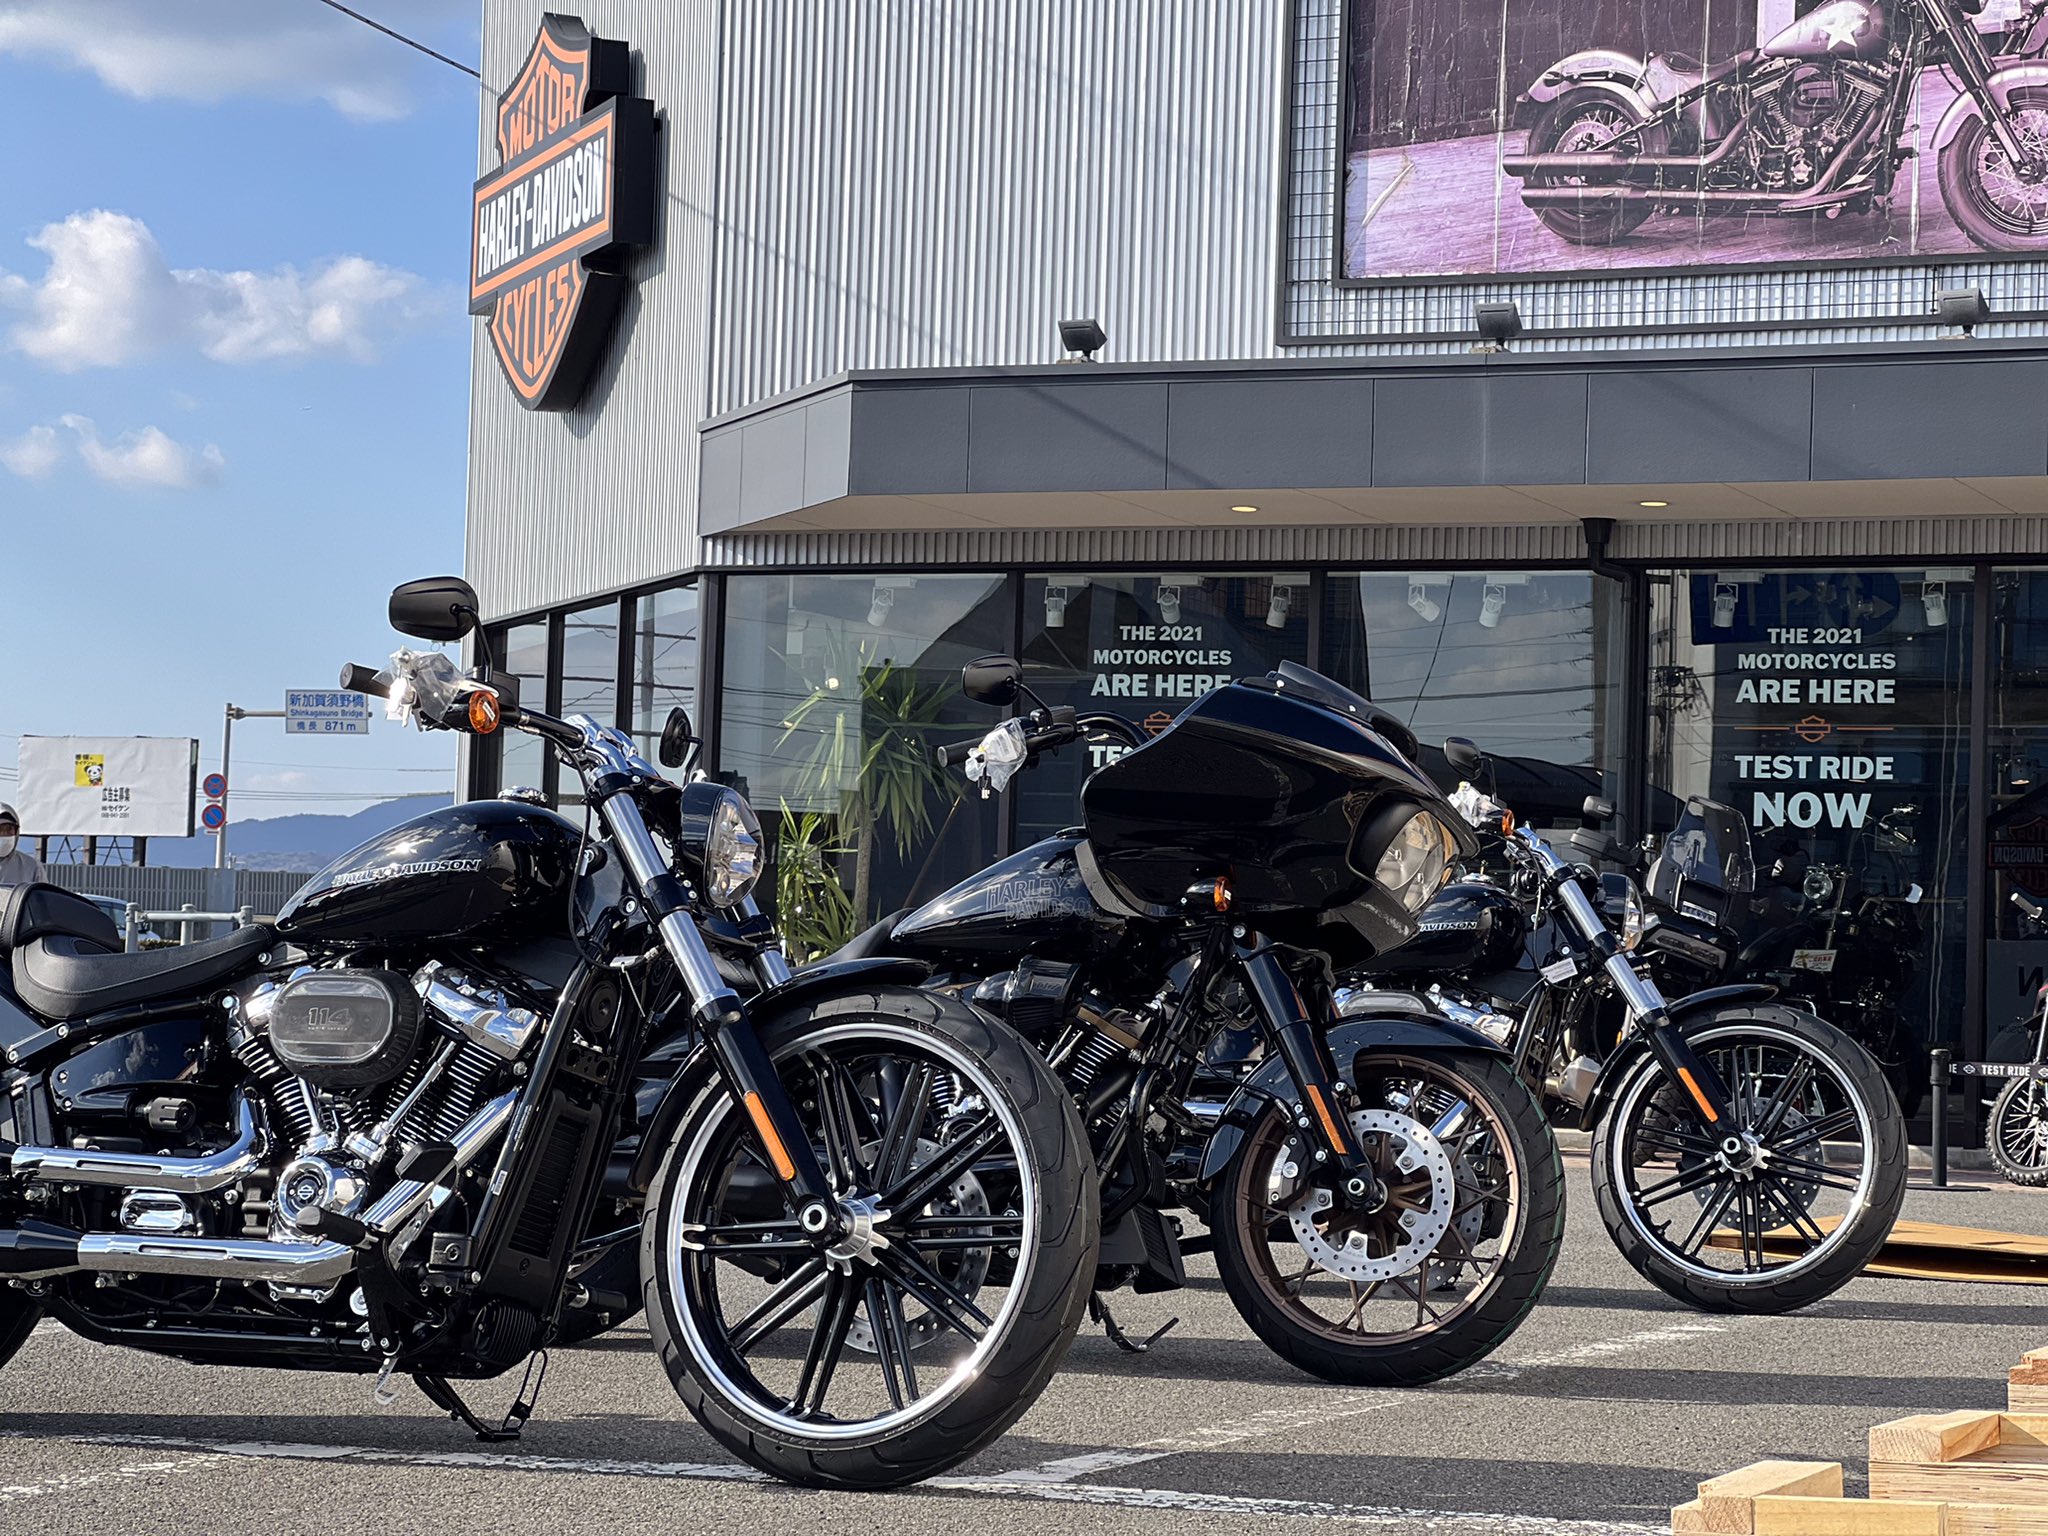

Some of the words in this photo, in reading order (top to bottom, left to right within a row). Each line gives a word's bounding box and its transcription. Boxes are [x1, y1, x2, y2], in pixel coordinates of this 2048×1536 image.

[509, 54, 576, 158] MOTOR
[478, 137, 604, 278] HARLEY-DAVIDSON
[502, 262, 570, 379] CYCLES
[1119, 625, 1156, 641] THE
[1159, 625, 1202, 641] 2021
[1767, 628, 1808, 644] THE
[1812, 628, 1862, 644] 2021
[1093, 649, 1232, 666] MOTORCYCLES
[1738, 653, 1896, 670] MOTORCYCLES
[1090, 673, 1149, 697] ARE
[1735, 679, 1801, 704] ARE
[1808, 679, 1896, 704] HERE
[289, 693, 364, 708] 新加賀須野橋
[290, 708, 339, 718] Shinkagasuno
[340, 709, 364, 718] Bridge
[1734, 755, 1813, 779] TEST
[1819, 756, 1894, 780] RIDE
[1753, 791, 1872, 829] NOW
[985, 878, 1067, 912] HARLEY
[1005, 897, 1092, 921] DAVIDSO
[1418, 921, 1478, 932] AVIDSON
[308, 1007, 352, 1026] 114
[1981, 1064, 2005, 1075] TEST
[2007, 1065, 2031, 1076] RIDE
